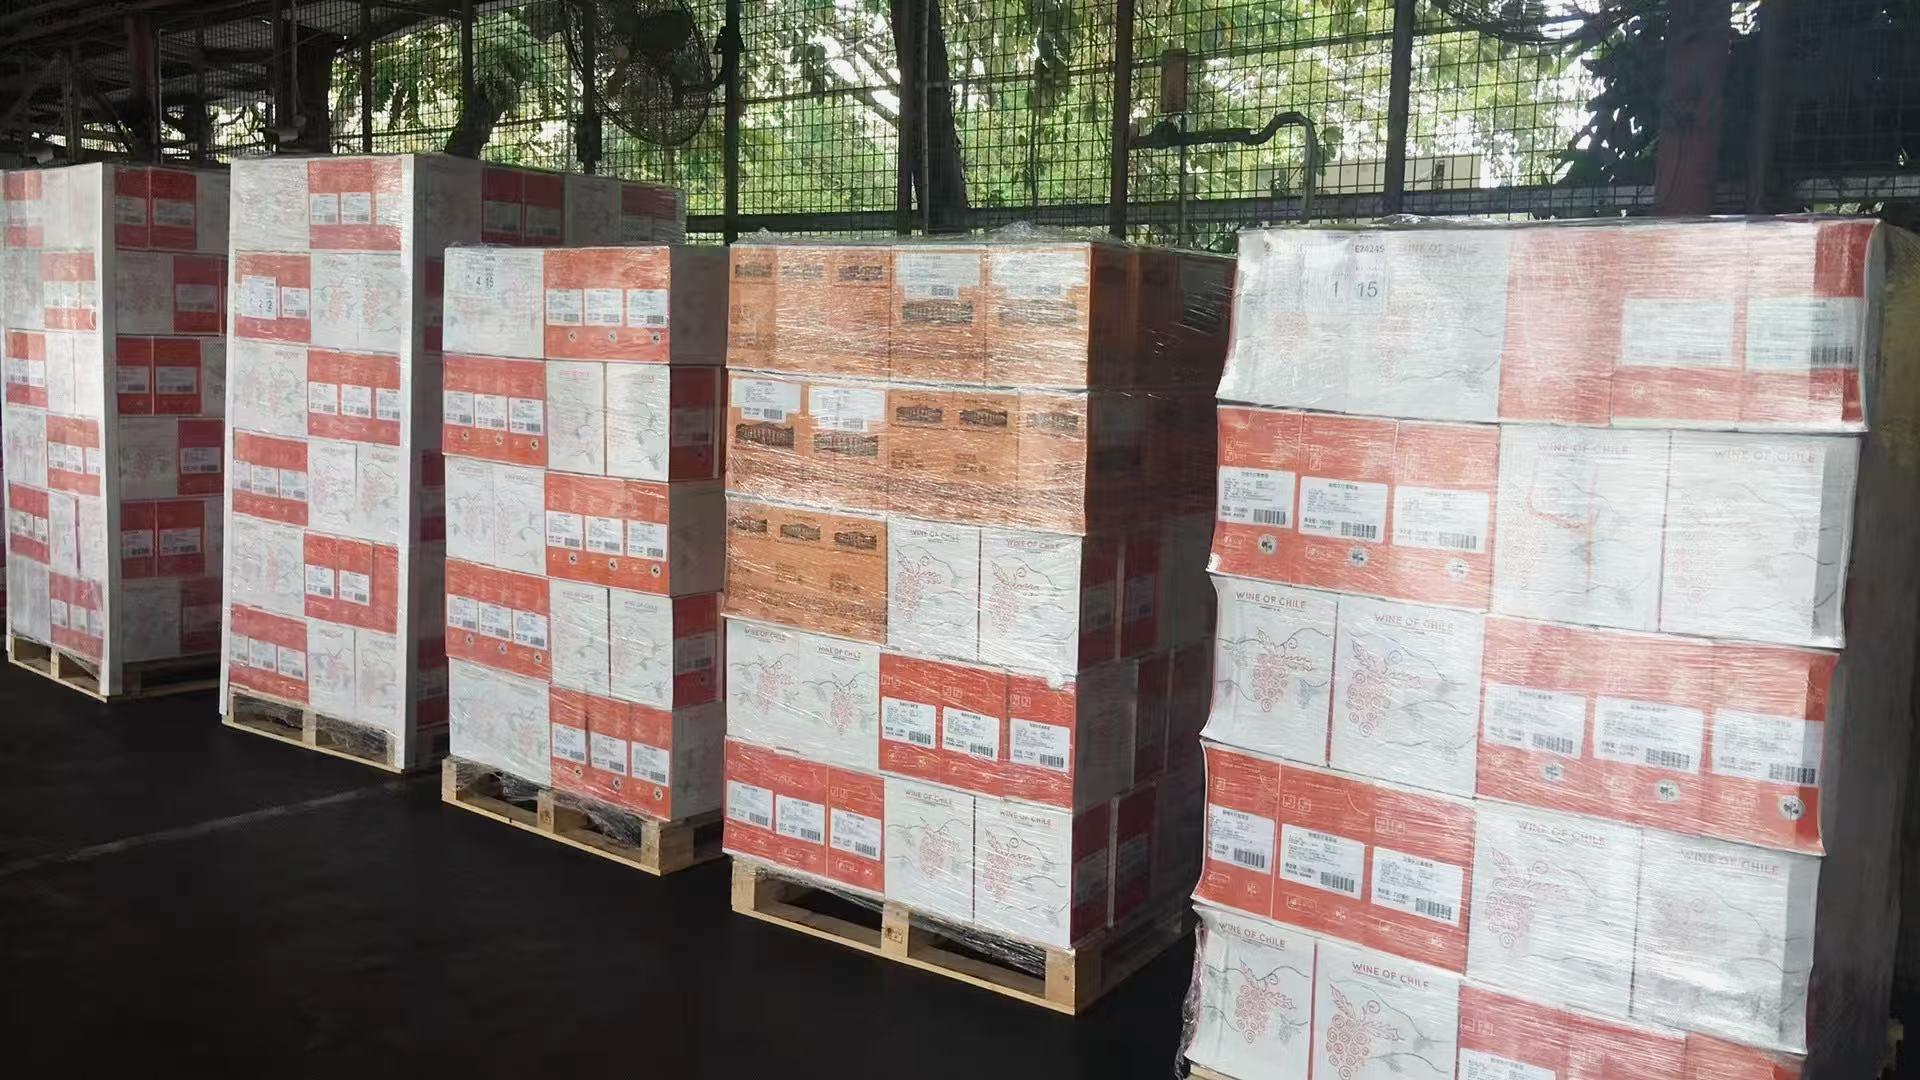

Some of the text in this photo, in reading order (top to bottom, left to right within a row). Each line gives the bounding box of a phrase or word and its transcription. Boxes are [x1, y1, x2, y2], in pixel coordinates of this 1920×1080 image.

[1332, 281, 1378, 298] 1 15
[1236, 591, 1306, 609] WINE OF CHILE
[1375, 614, 1454, 632] WINE OF CHILE
[1218, 921, 1286, 948] WINE OF CHILE
[1352, 961, 1429, 989] WINE OF CHILE
